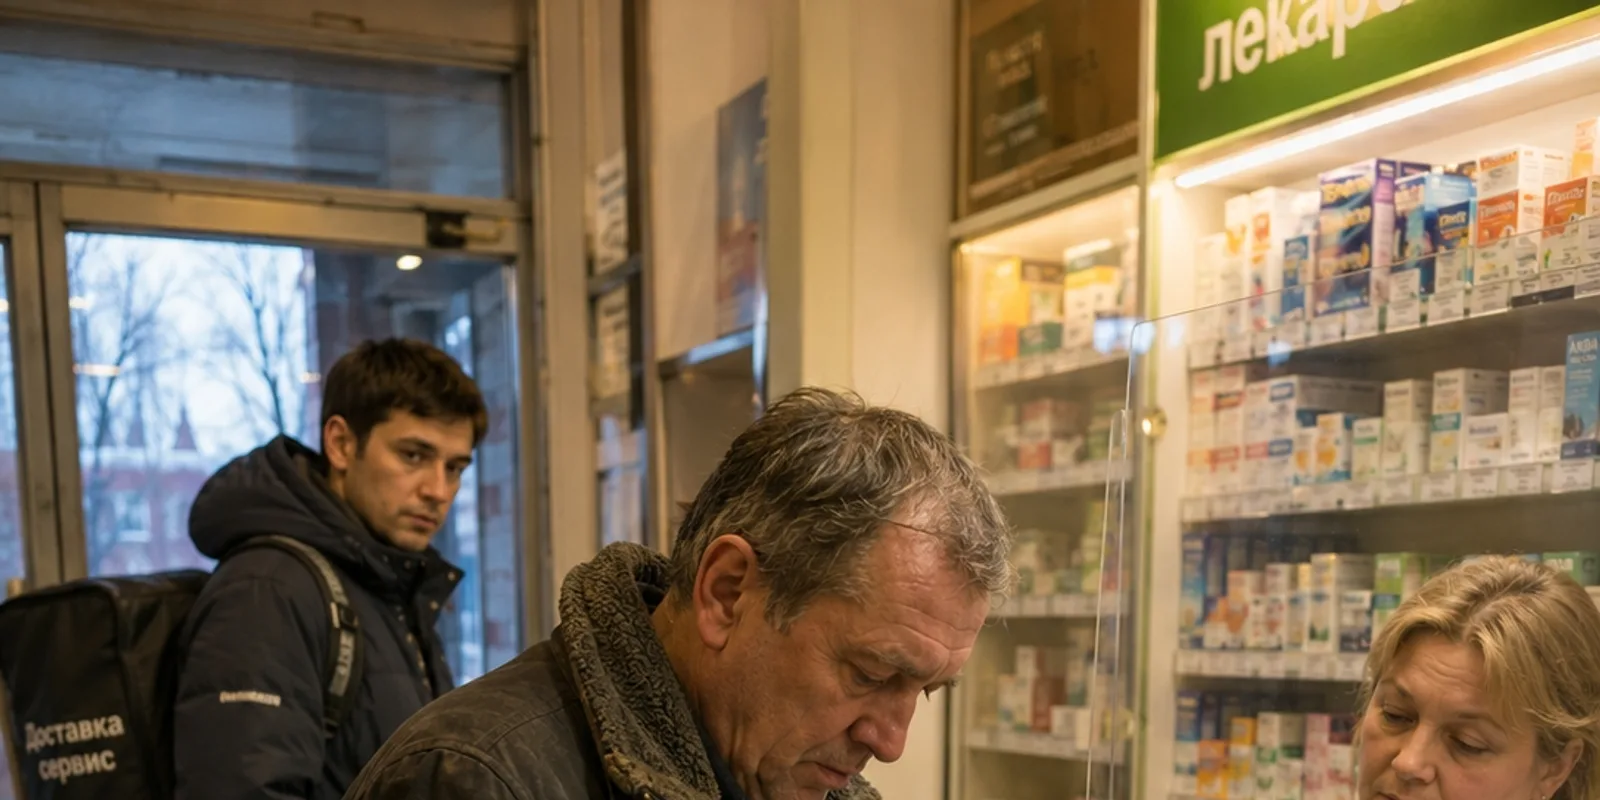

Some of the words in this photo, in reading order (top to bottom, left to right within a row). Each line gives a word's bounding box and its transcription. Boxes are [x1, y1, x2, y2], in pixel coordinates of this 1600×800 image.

[1199, 0, 1409, 91] лекар
[25, 715, 124, 754] Доставка
[39, 750, 116, 785] сервис
